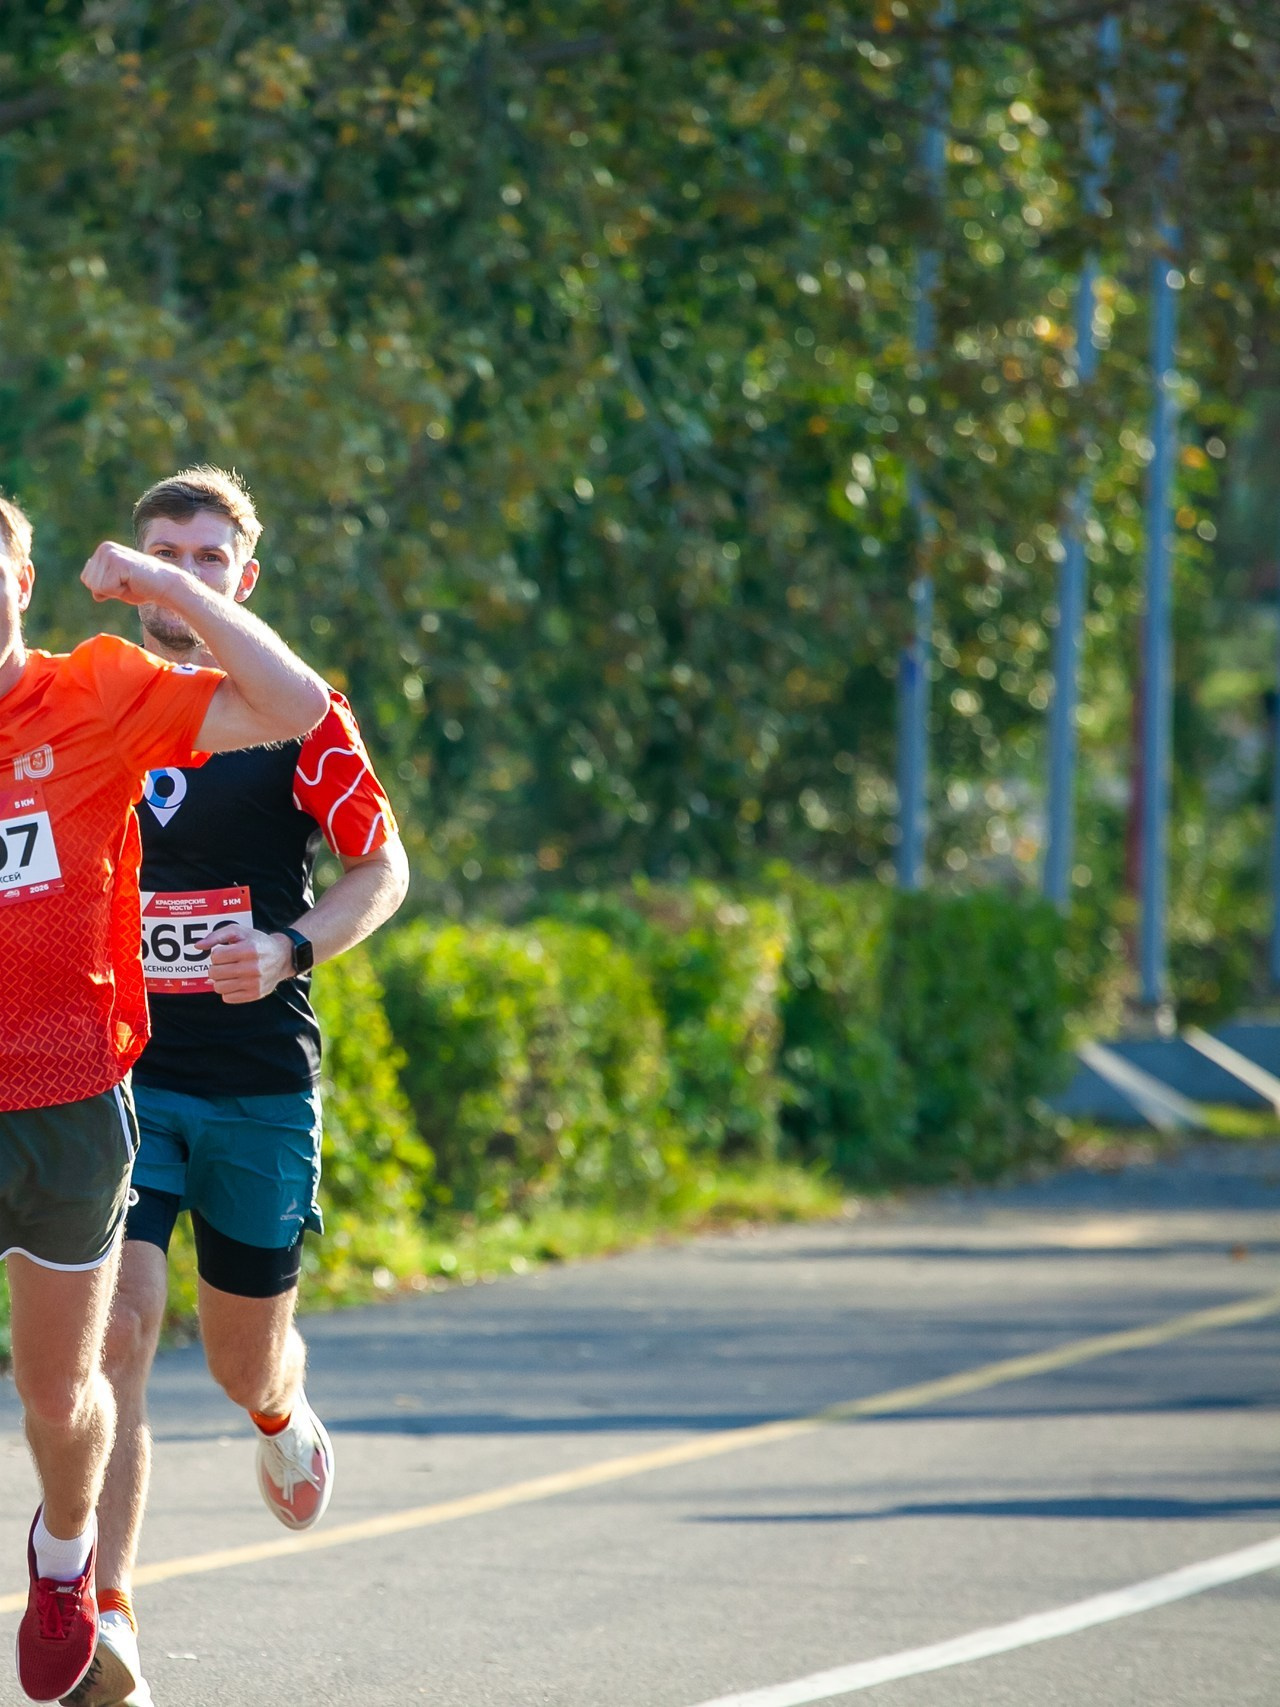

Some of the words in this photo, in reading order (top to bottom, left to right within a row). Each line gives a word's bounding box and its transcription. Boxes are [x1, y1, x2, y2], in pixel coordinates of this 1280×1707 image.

[14, 801, 21, 809] 5
[29, 883, 50, 894] 2026
[155, 898, 206, 906] КРАСНОЯРСКИЕ
[222, 899, 228, 907] 5
[142, 920, 240, 963] 65
[144, 965, 174, 973] АСЕНКО
[175, 964, 212, 973] КОНСТА
